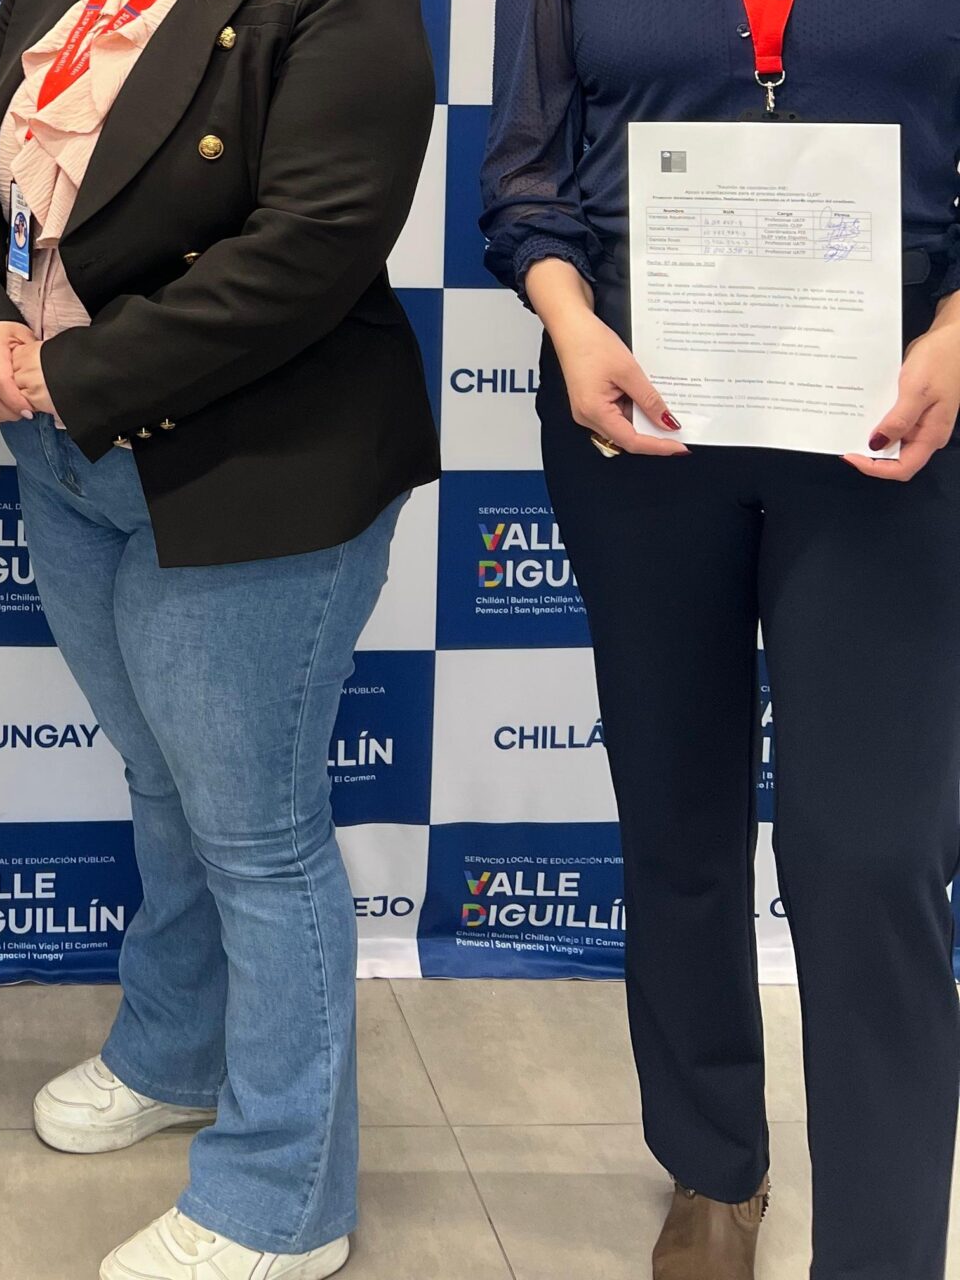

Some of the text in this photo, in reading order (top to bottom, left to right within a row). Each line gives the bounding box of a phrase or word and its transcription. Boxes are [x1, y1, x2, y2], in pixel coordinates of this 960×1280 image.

[450, 368, 541, 394] CHILL
[478, 523, 566, 551] VALL
[494, 717, 605, 750] CHILLÁ
[463, 870, 580, 897] VALLE
[354, 895, 414, 918] EJO
[461, 898, 626, 931] DIGUILLÍ
